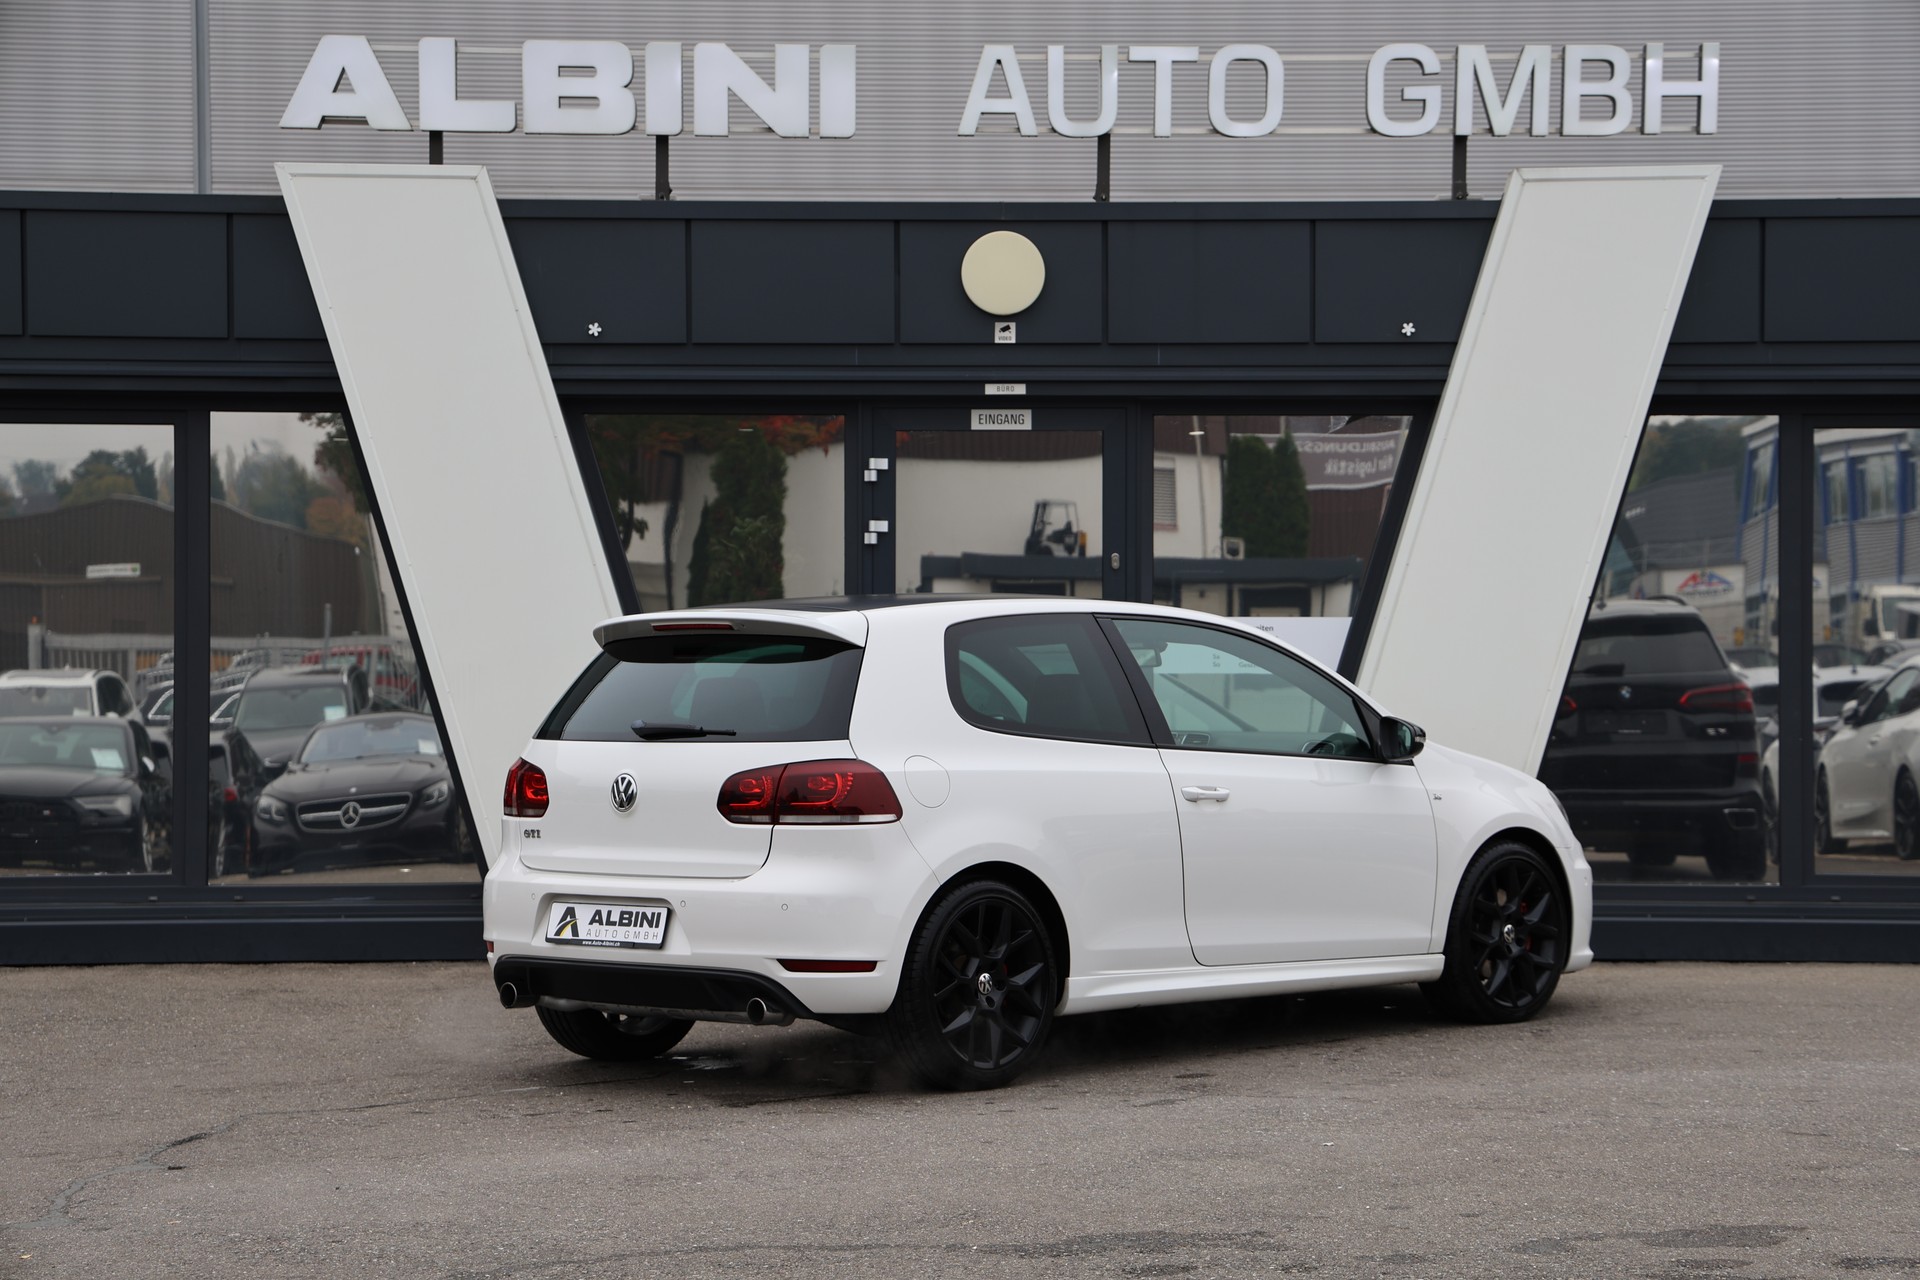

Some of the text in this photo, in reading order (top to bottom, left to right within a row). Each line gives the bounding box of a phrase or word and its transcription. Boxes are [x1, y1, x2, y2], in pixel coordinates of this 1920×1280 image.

[279, 35, 1720, 138] ALBINI AUTO GMBH
[996, 384, 1015, 392] BÜRO
[978, 413, 1025, 425] EINGANG
[523, 829, 542, 839] GTI
[588, 909, 661, 928] ALBINI
[585, 928, 659, 940] AUTO GMBH
